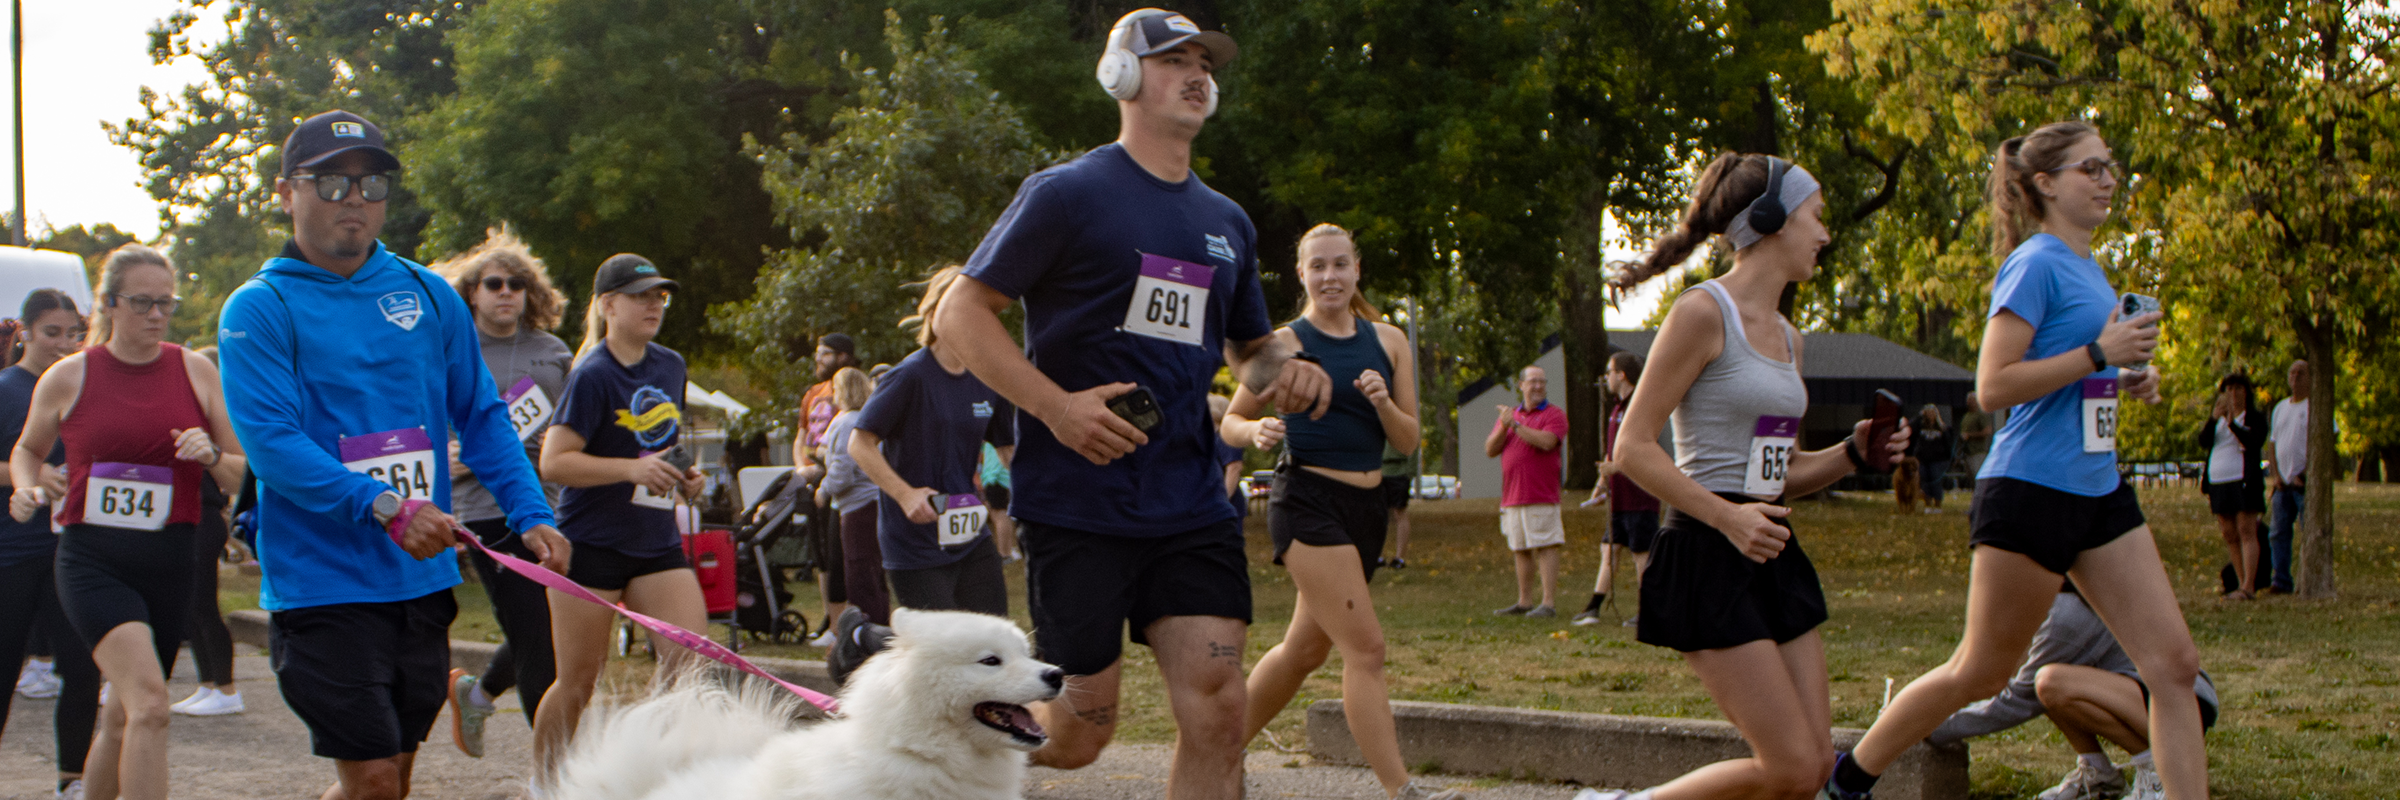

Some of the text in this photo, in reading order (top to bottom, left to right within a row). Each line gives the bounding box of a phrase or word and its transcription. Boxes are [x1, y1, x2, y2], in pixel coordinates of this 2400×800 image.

[1146, 287, 1191, 329] 691
[100, 485, 155, 518] 634
[949, 511, 980, 536] 670
